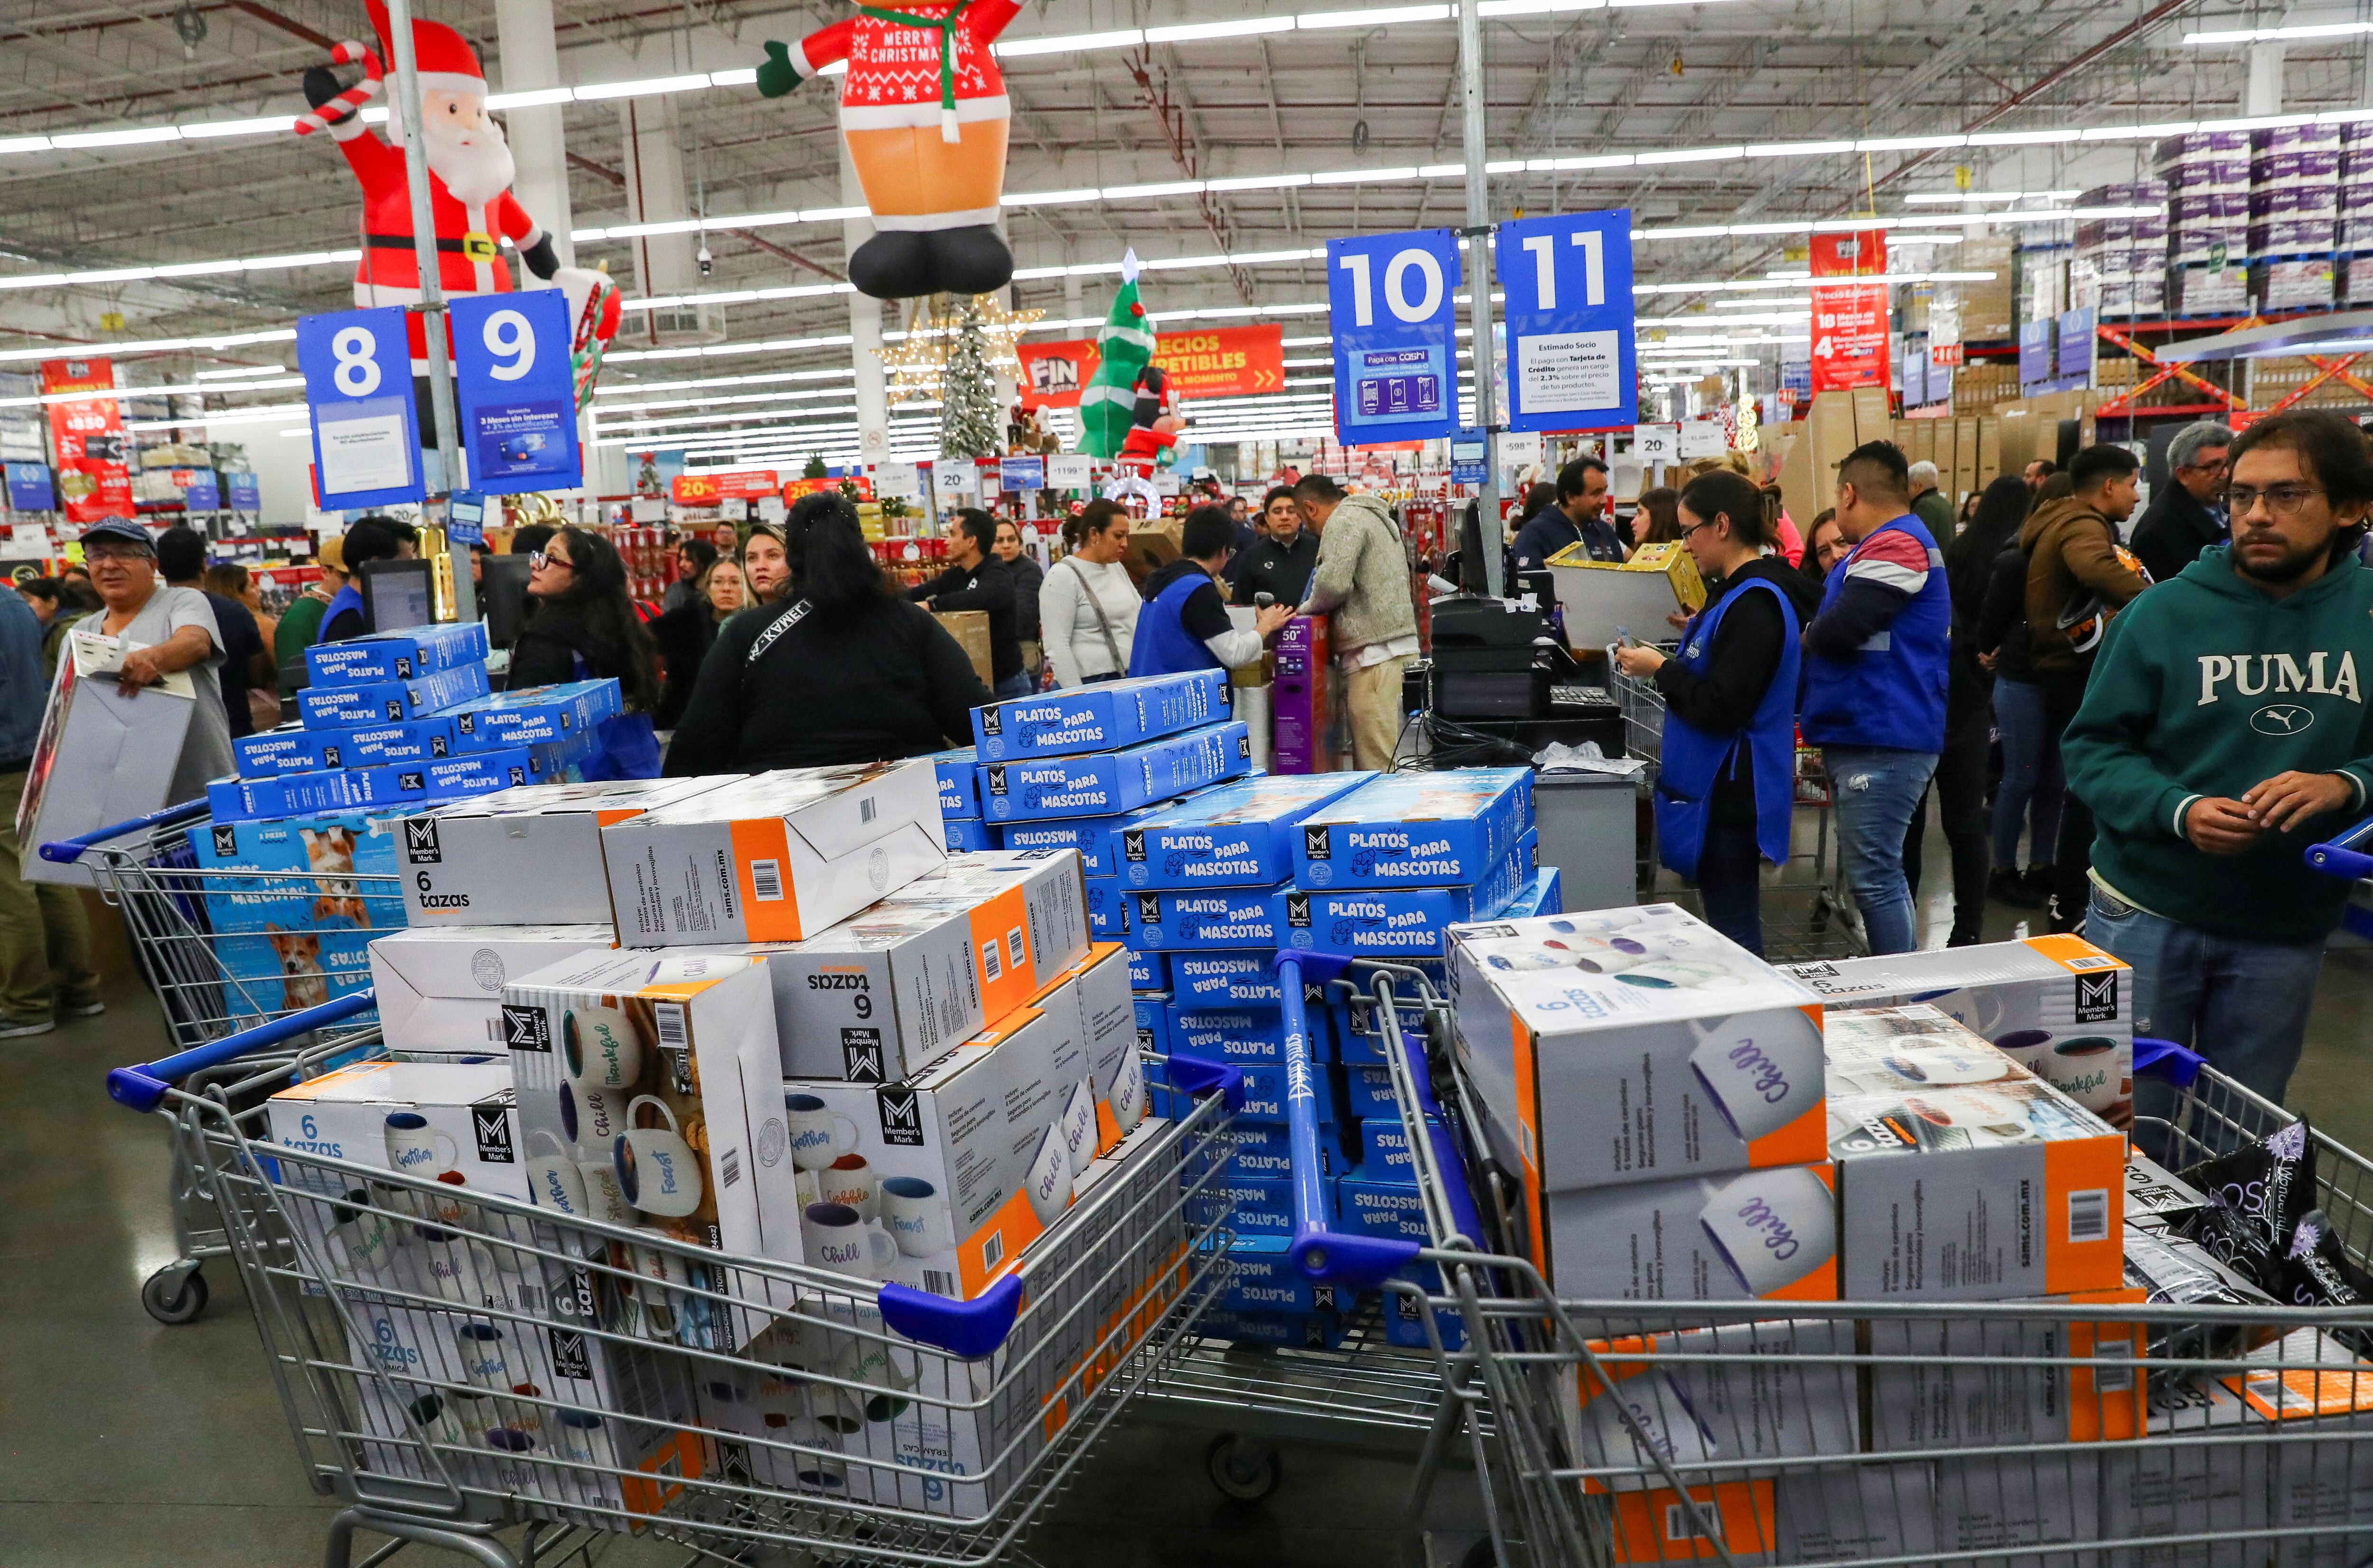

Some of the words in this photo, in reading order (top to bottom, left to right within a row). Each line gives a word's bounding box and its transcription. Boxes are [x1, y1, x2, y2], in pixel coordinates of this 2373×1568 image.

[884, 30, 929, 47] MERRY
[871, 46, 943, 64] CHRISTMA
[1523, 230, 1605, 310] 11
[1340, 248, 1443, 327] 10
[483, 309, 536, 381] 9
[1154, 336, 1220, 355] ECIOS
[1539, 343, 1573, 351] Estimado
[1814, 336, 1834, 359] 4
[332, 327, 381, 397] 8
[1148, 352, 1246, 373] PETIBLES
[1368, 356, 1383, 365] Paga
[1029, 358, 1078, 385] FIN
[315, 650, 367, 663] MASCOTAS
[322, 663, 346, 674] PARA
[347, 666, 384, 677] PLATOS
[2198, 650, 2362, 706] PUMA
[308, 693, 358, 706] MASCOTAS
[315, 706, 338, 718] PARA
[341, 709, 375, 719] PLATOS
[485, 714, 521, 725] PLATOS
[523, 716, 547, 729] PARA
[1015, 707, 1062, 722] PLATOS
[1063, 710, 1094, 728] PARA
[501, 727, 553, 741] MASCOTAS
[1037, 727, 1103, 747] MASCOTAS
[245, 740, 296, 755] MASCOTAS
[1216, 735, 1224, 773] PLATOS
[252, 753, 276, 766] PARA
[278, 756, 313, 767] PLATOS
[1204, 737, 1212, 779] MASCOTAS
[1021, 770, 1066, 784] PLATOS
[1067, 774, 1098, 791] PARA
[1041, 791, 1107, 809] MASCOTAS
[1014, 831, 1077, 846] MASCOTAS
[1161, 835, 1213, 850] PLATOS
[1215, 841, 1250, 859] PARA
[1349, 833, 1408, 848] PLATOS
[1410, 840, 1450, 859] PARA
[648, 846, 659, 885] lavavajillas
[1185, 860, 1259, 877] MASCOTAS
[1375, 860, 1460, 877] MASCOTAS
[416, 871, 431, 891] 6
[636, 864, 645, 896] cerámica
[718, 849, 733, 919] sams.com.mx
[420, 893, 469, 907] tazas
[642, 896, 646, 905] de
[1177, 899, 1227, 914] PLATOS
[1230, 905, 1264, 921] PARA
[636, 906, 645, 933] Incluye:
[657, 892, 665, 931] Microondas
[1329, 902, 1385, 918] PLATOS
[1387, 911, 1426, 928] PARA
[1029, 902, 1042, 965] sams.com.mx
[1200, 924, 1273, 939] MASCOTAS
[1354, 931, 1436, 945] MASCOTAS
[963, 941, 977, 1009] sams.com.mx
[1184, 959, 1259, 975] MASCOTAS
[808, 974, 869, 992] tazas
[1192, 977, 1227, 993] PARA
[1230, 982, 1280, 999] PLATOS
[1812, 980, 1831, 989] 6
[1818, 981, 1886, 995] tazas
[854, 994, 872, 1019] 6
[1536, 1000, 1570, 1012] 6
[2078, 1004, 2115, 1015] Member's
[533, 1009, 543, 1050] Member's
[540, 1017, 549, 1041] Mark.
[844, 1036, 878, 1047] Member's
[1728, 1038, 1790, 1104] Chill
[1120, 1066, 1137, 1112] Chill
[587, 1092, 610, 1137] Chill
[948, 1106, 963, 1120] Incluye:
[953, 1114, 963, 1125] tazas
[301, 1115, 317, 1139] 6
[885, 1127, 921, 1136] Member's
[951, 1124, 966, 1138] Seguras
[967, 1117, 976, 1127] para
[1069, 1105, 1088, 1154] Chill
[396, 1147, 433, 1167] Gather
[480, 1144, 511, 1154] Member's
[488, 1153, 507, 1161] Mark.
[651, 1150, 678, 1194] Feast
[1040, 1149, 1062, 1202] Chill
[970, 1189, 1003, 1223] sams.com.mx
[893, 1213, 925, 1233] Feast
[1738, 1197, 1799, 1260] Chill
[2021, 1179, 2030, 1268] sams.com.mx
[822, 1242, 860, 1263] Chill
[1243, 1287, 1295, 1302] PLATOS
